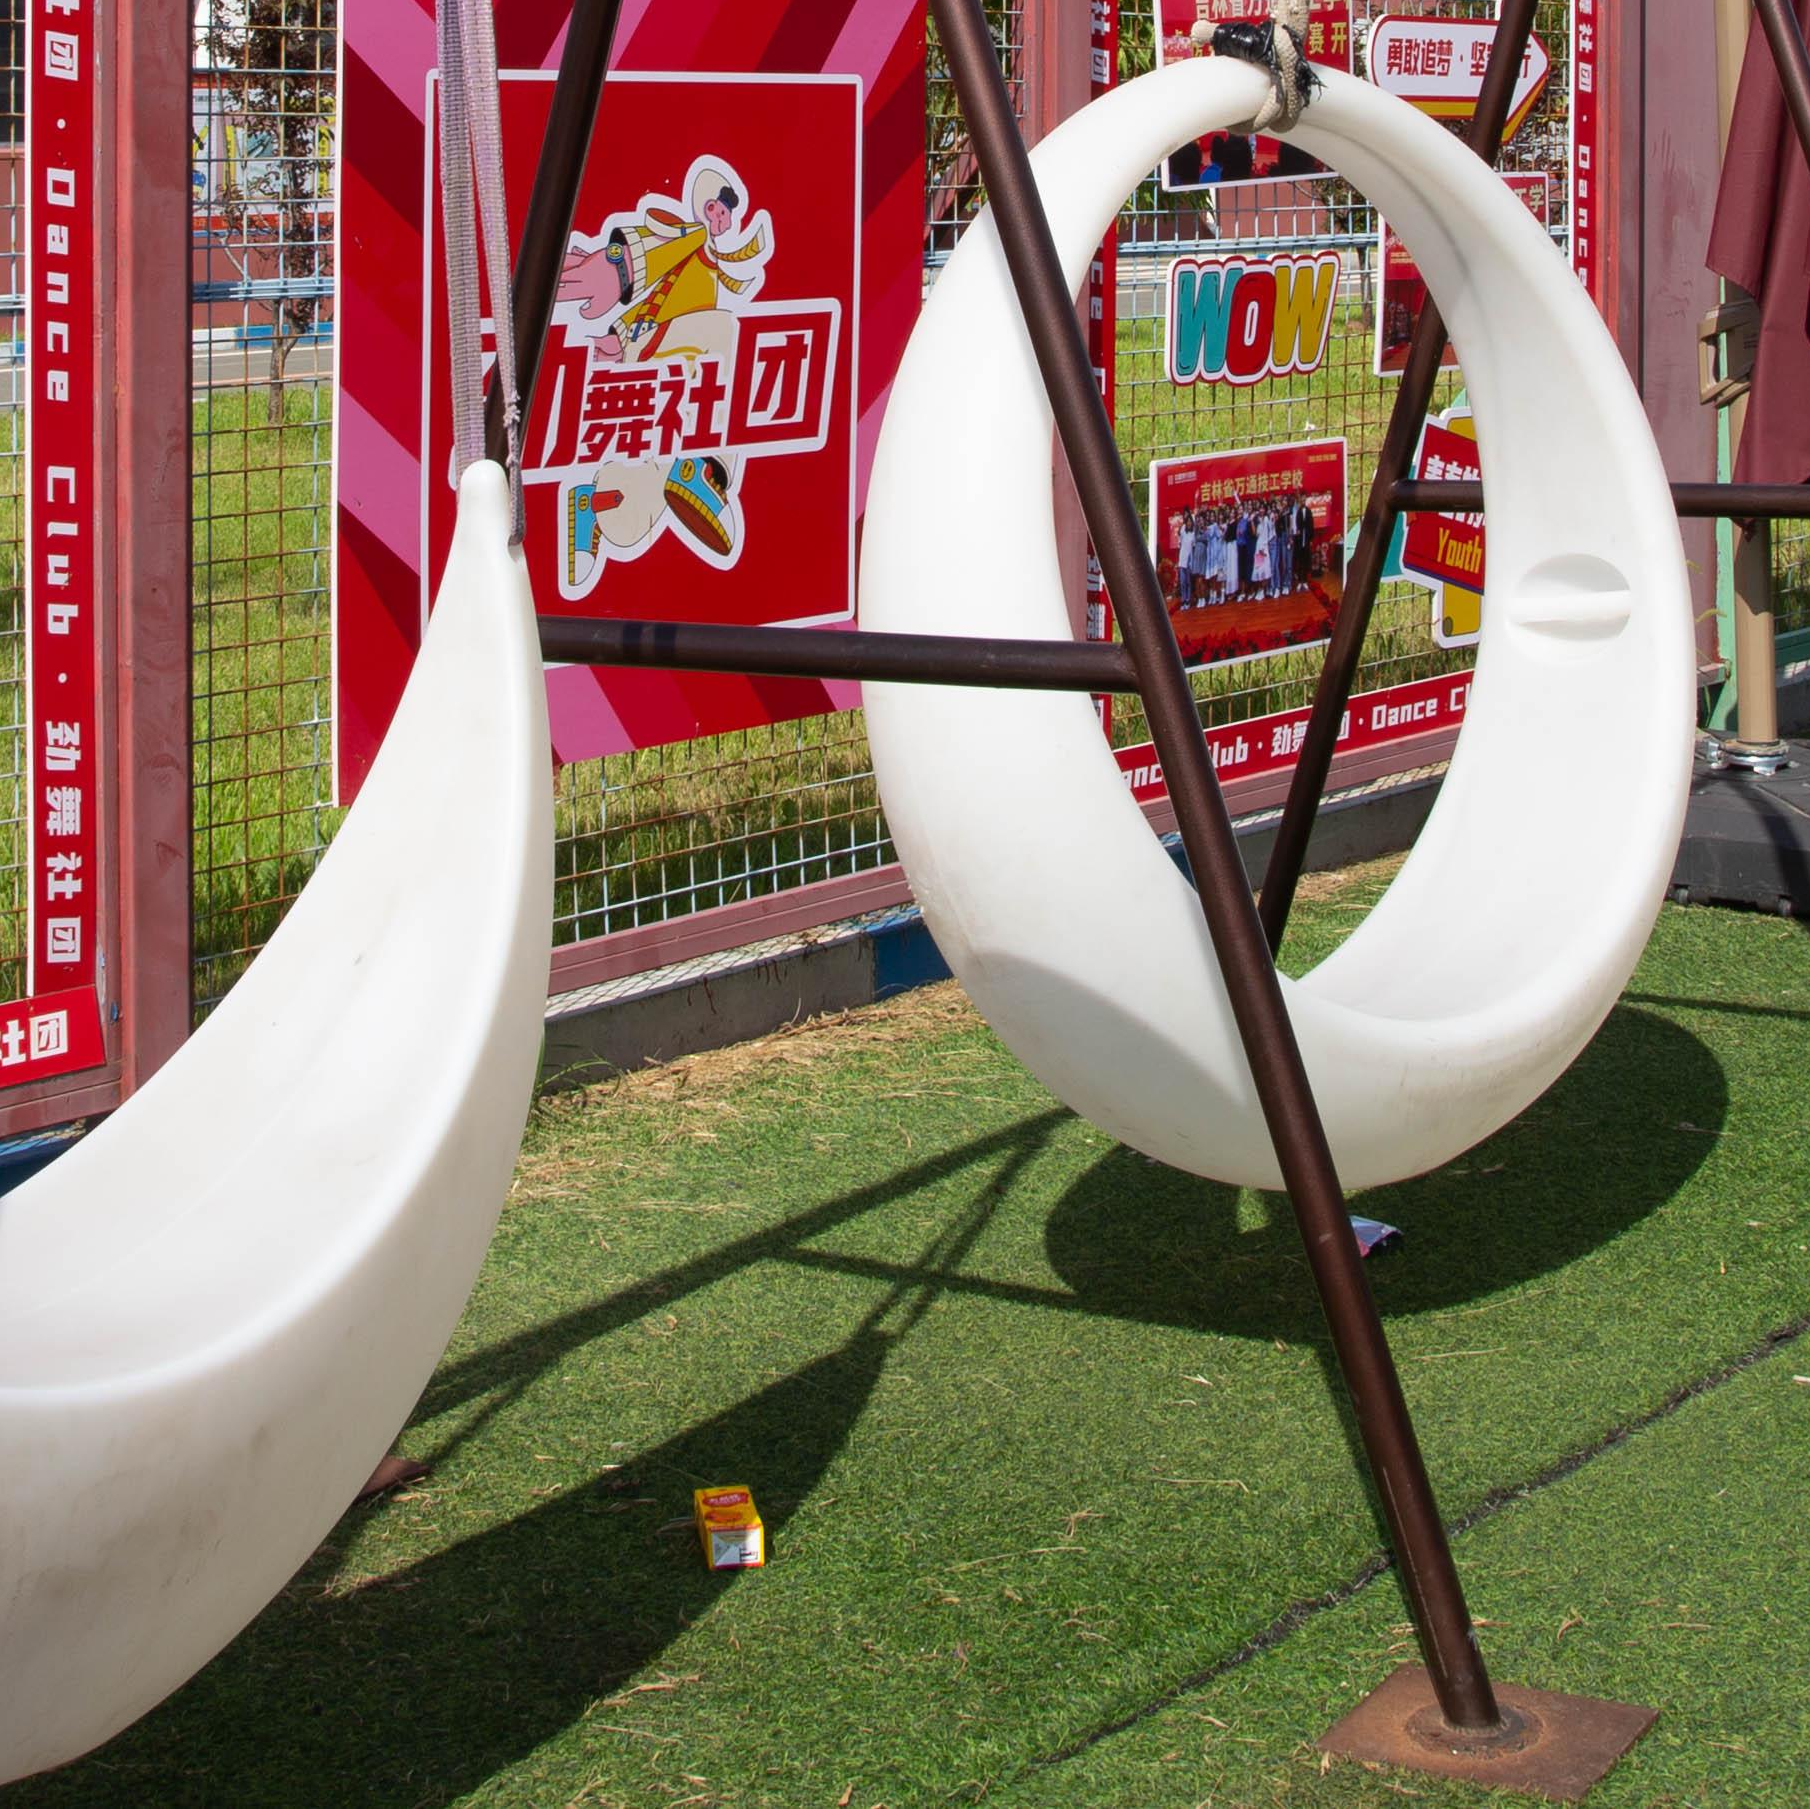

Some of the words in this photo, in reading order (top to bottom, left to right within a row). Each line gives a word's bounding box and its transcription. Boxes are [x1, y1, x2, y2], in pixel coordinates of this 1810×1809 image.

[46, 167, 76, 403] Dance
[1177, 262, 1334, 378] WOW
[47, 466, 79, 635] Club
[1437, 527, 1483, 574] Youth
[1372, 697, 1439, 731] Dance
[45, 720, 82, 964] 劲舞社团
